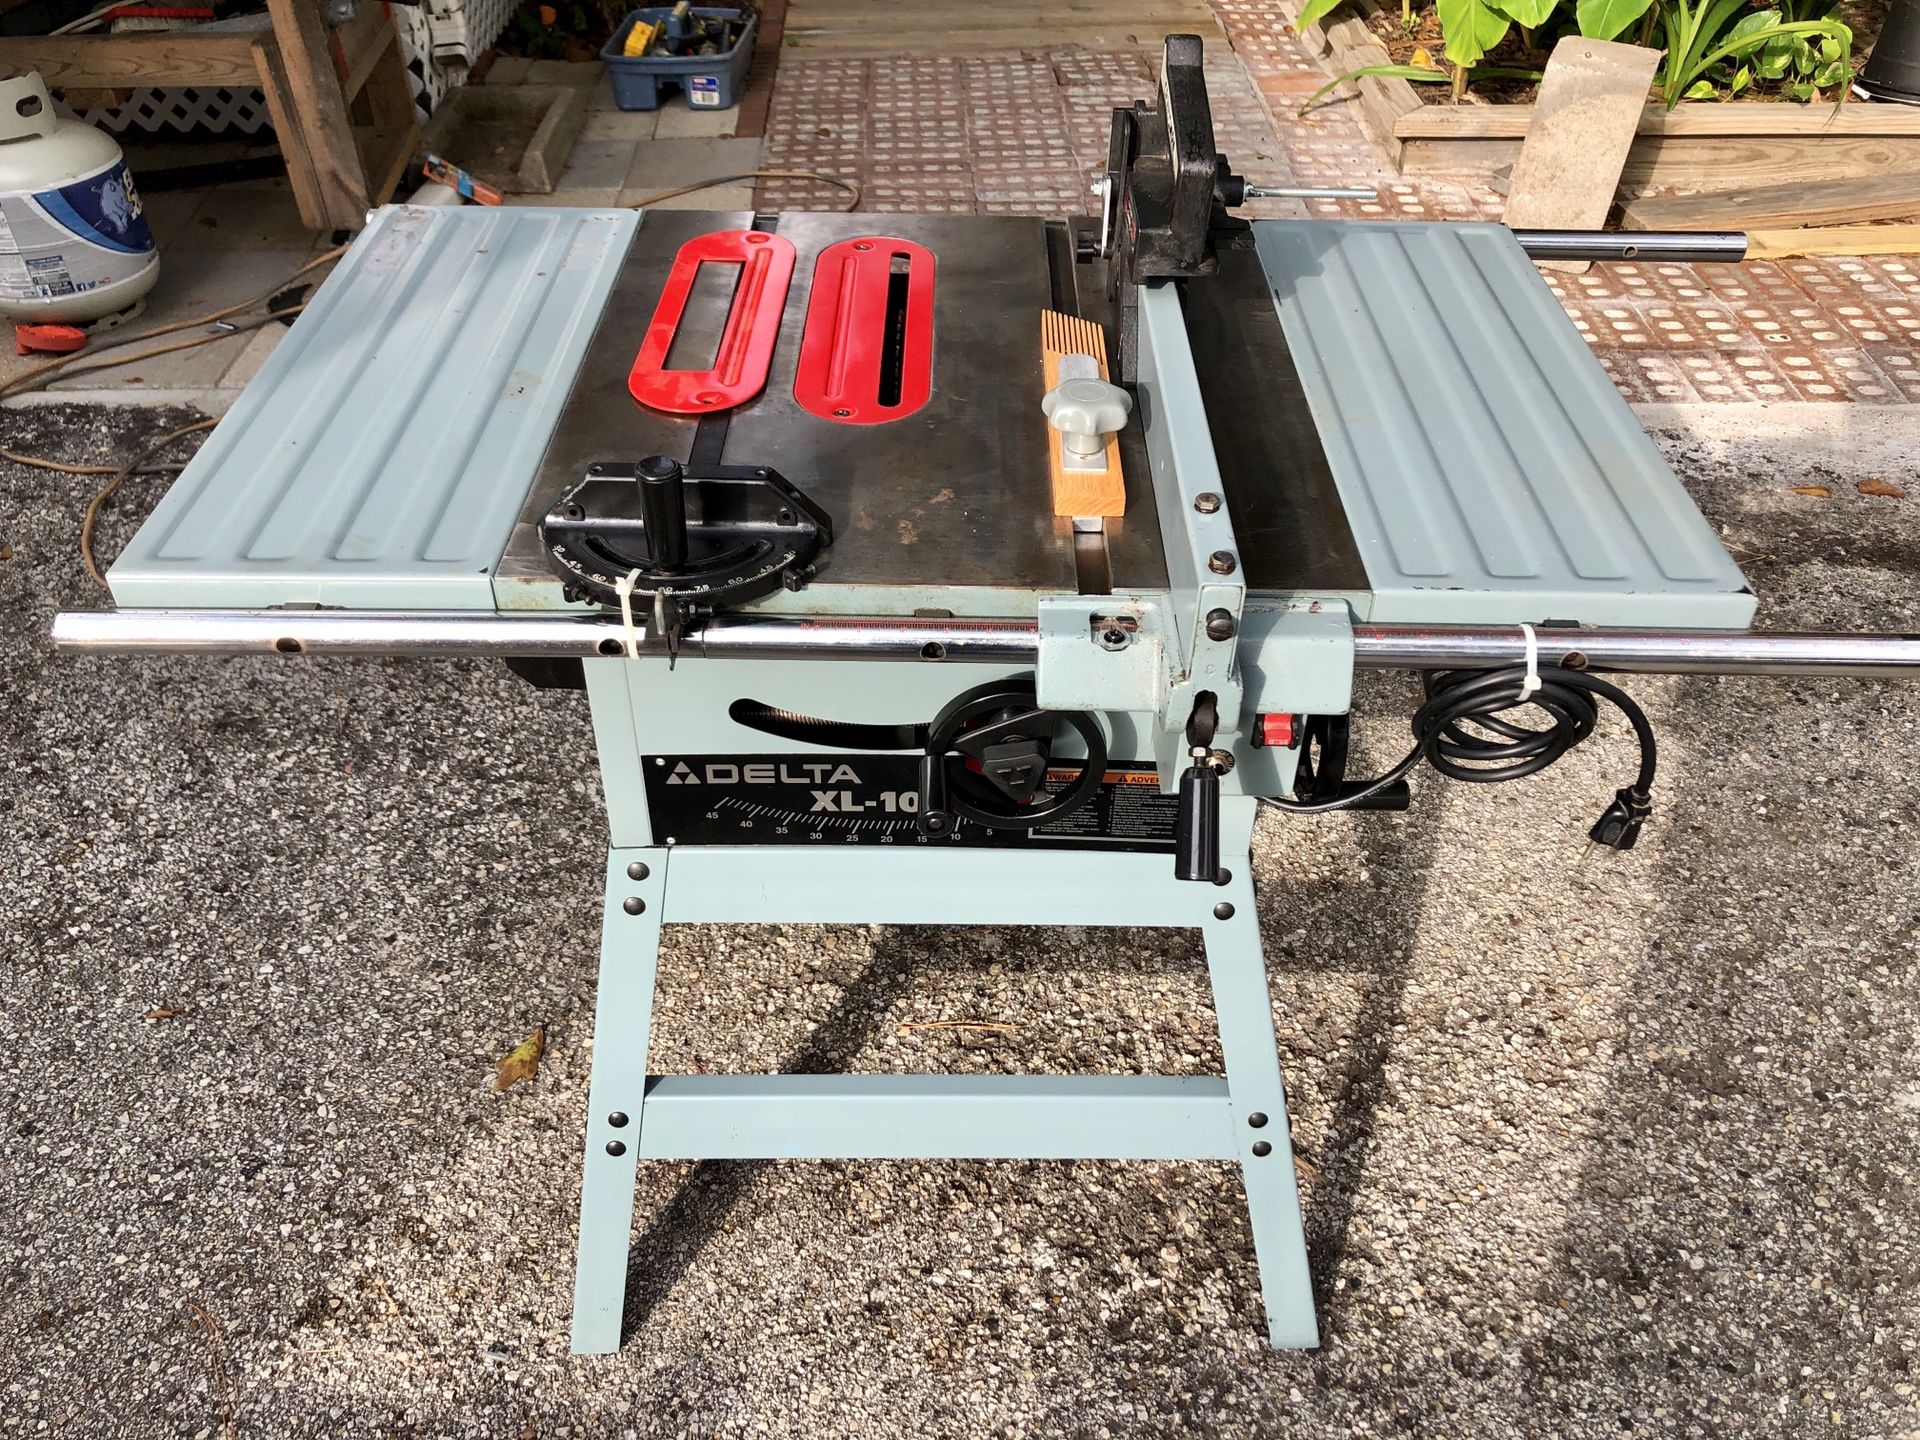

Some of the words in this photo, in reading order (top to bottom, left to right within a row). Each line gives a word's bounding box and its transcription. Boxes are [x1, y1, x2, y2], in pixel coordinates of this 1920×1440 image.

[591, 573, 607, 582] 60
[705, 763, 862, 784] DELTA
[810, 790, 919, 813] XL-10
[705, 811, 719, 819] 45
[740, 820, 753, 828] 40
[775, 826, 788, 834] 35
[986, 828, 993, 836] 5
[809, 832, 823, 840] 30
[846, 834, 859, 842] 25
[880, 834, 893, 843] 20
[916, 835, 928, 843] 15
[949, 833, 961, 841] 10
